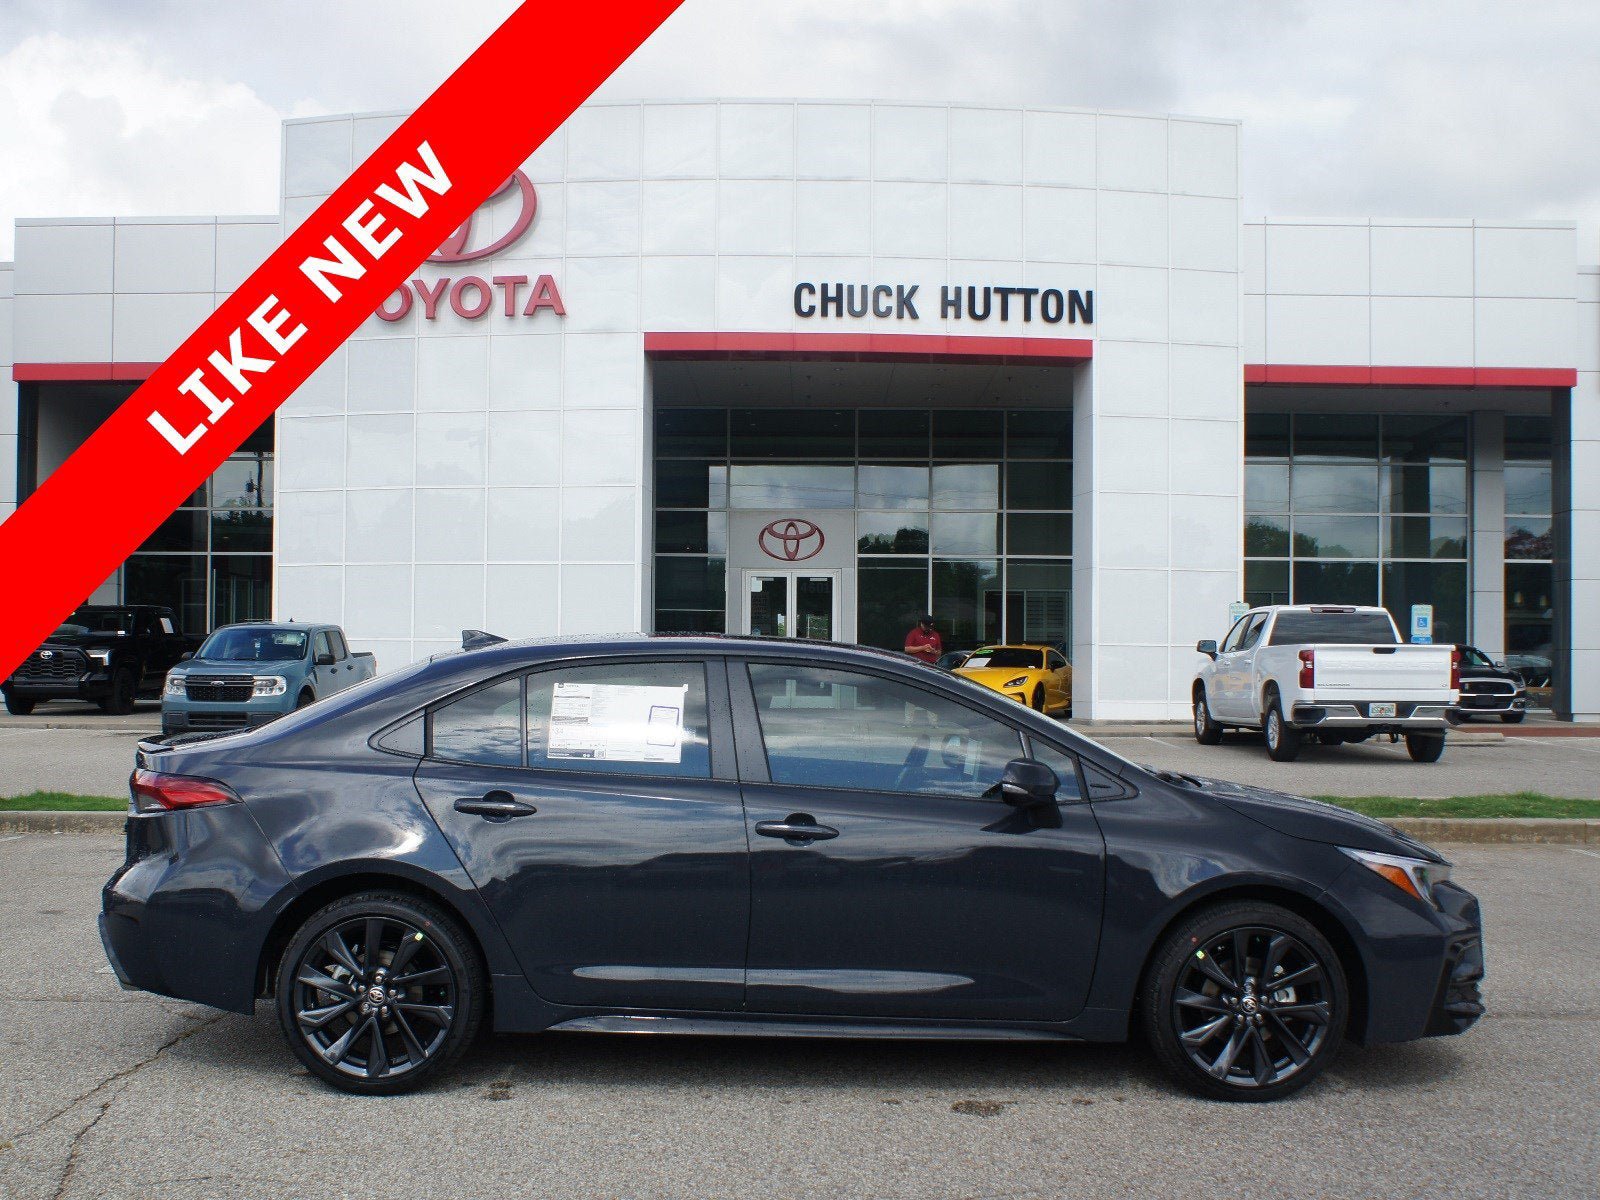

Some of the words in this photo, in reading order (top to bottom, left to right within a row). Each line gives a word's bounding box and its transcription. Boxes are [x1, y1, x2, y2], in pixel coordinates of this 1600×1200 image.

[374, 274, 567, 322] OYOTA
[794, 282, 920, 319] CHUCK
[940, 285, 1094, 324] HUTTON
